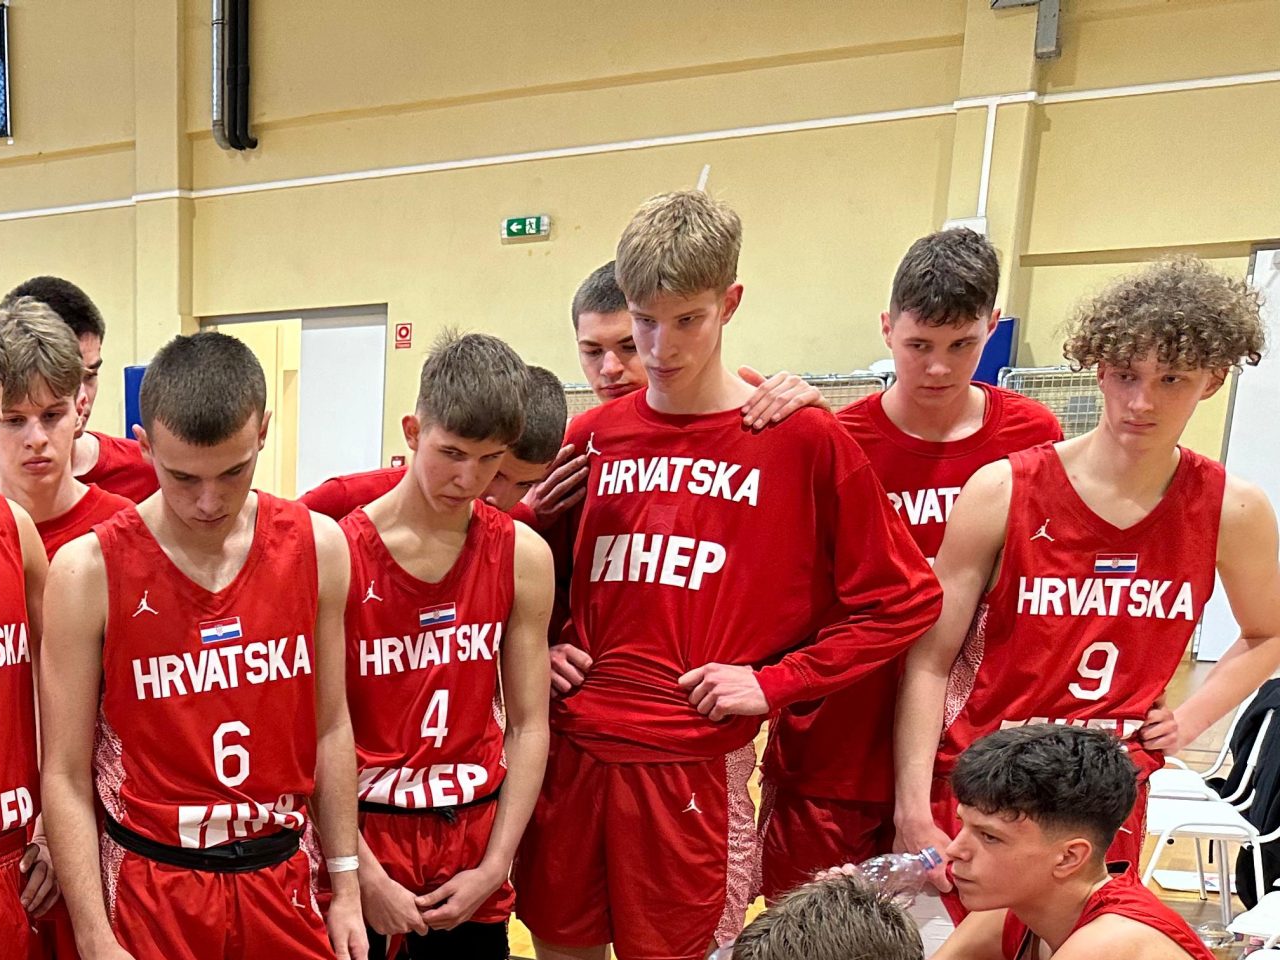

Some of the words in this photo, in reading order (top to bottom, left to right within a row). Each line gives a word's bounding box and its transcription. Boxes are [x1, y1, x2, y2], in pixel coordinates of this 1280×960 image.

[597, 456, 761, 507] HRVATSKA
[628, 533, 727, 591] HEP
[1017, 576, 1194, 621] HRVATSKA
[132, 634, 312, 700] HRVATSKA
[1068, 641, 1120, 700] 9
[420, 689, 450, 748] 4
[212, 720, 251, 788] 6
